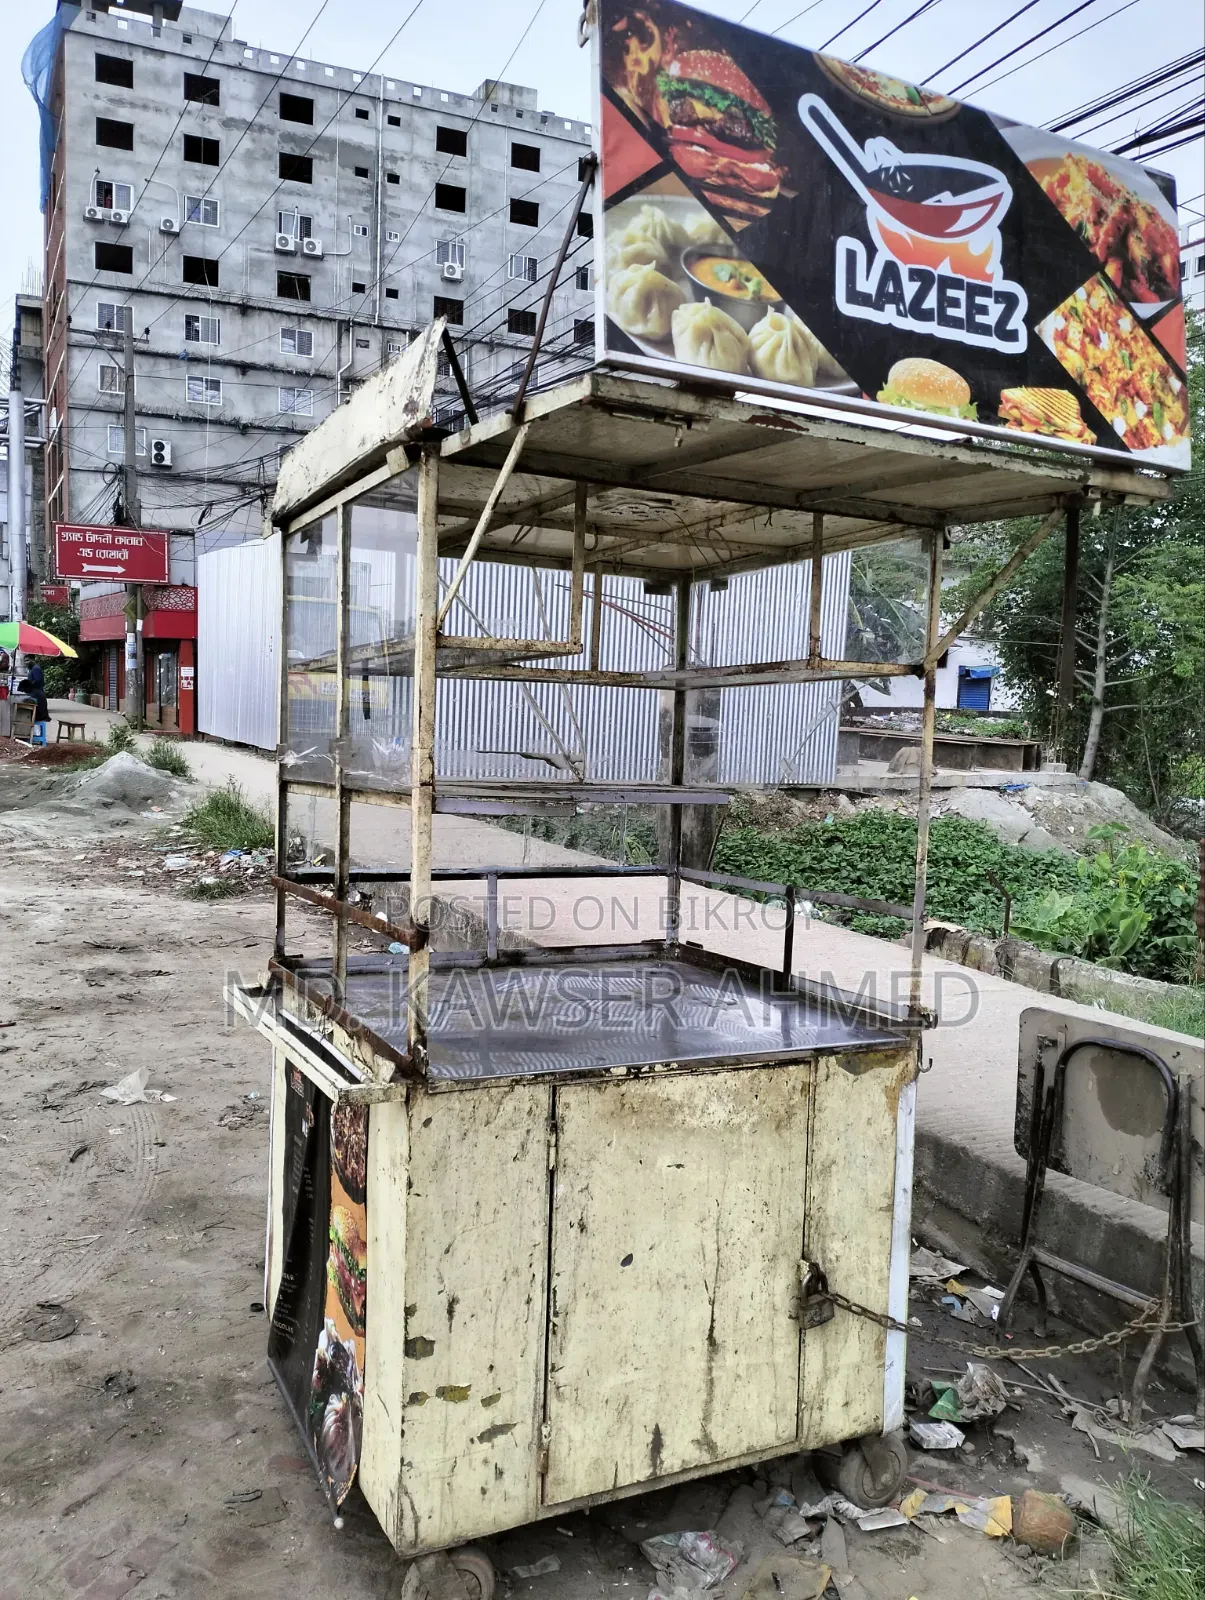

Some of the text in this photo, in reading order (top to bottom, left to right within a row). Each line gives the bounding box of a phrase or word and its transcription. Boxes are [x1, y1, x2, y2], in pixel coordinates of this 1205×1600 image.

[843, 246, 1021, 344] LAZEEZ
[85, 531, 112, 544] চাঁদনী
[114, 536, 143, 547] কাবাব
